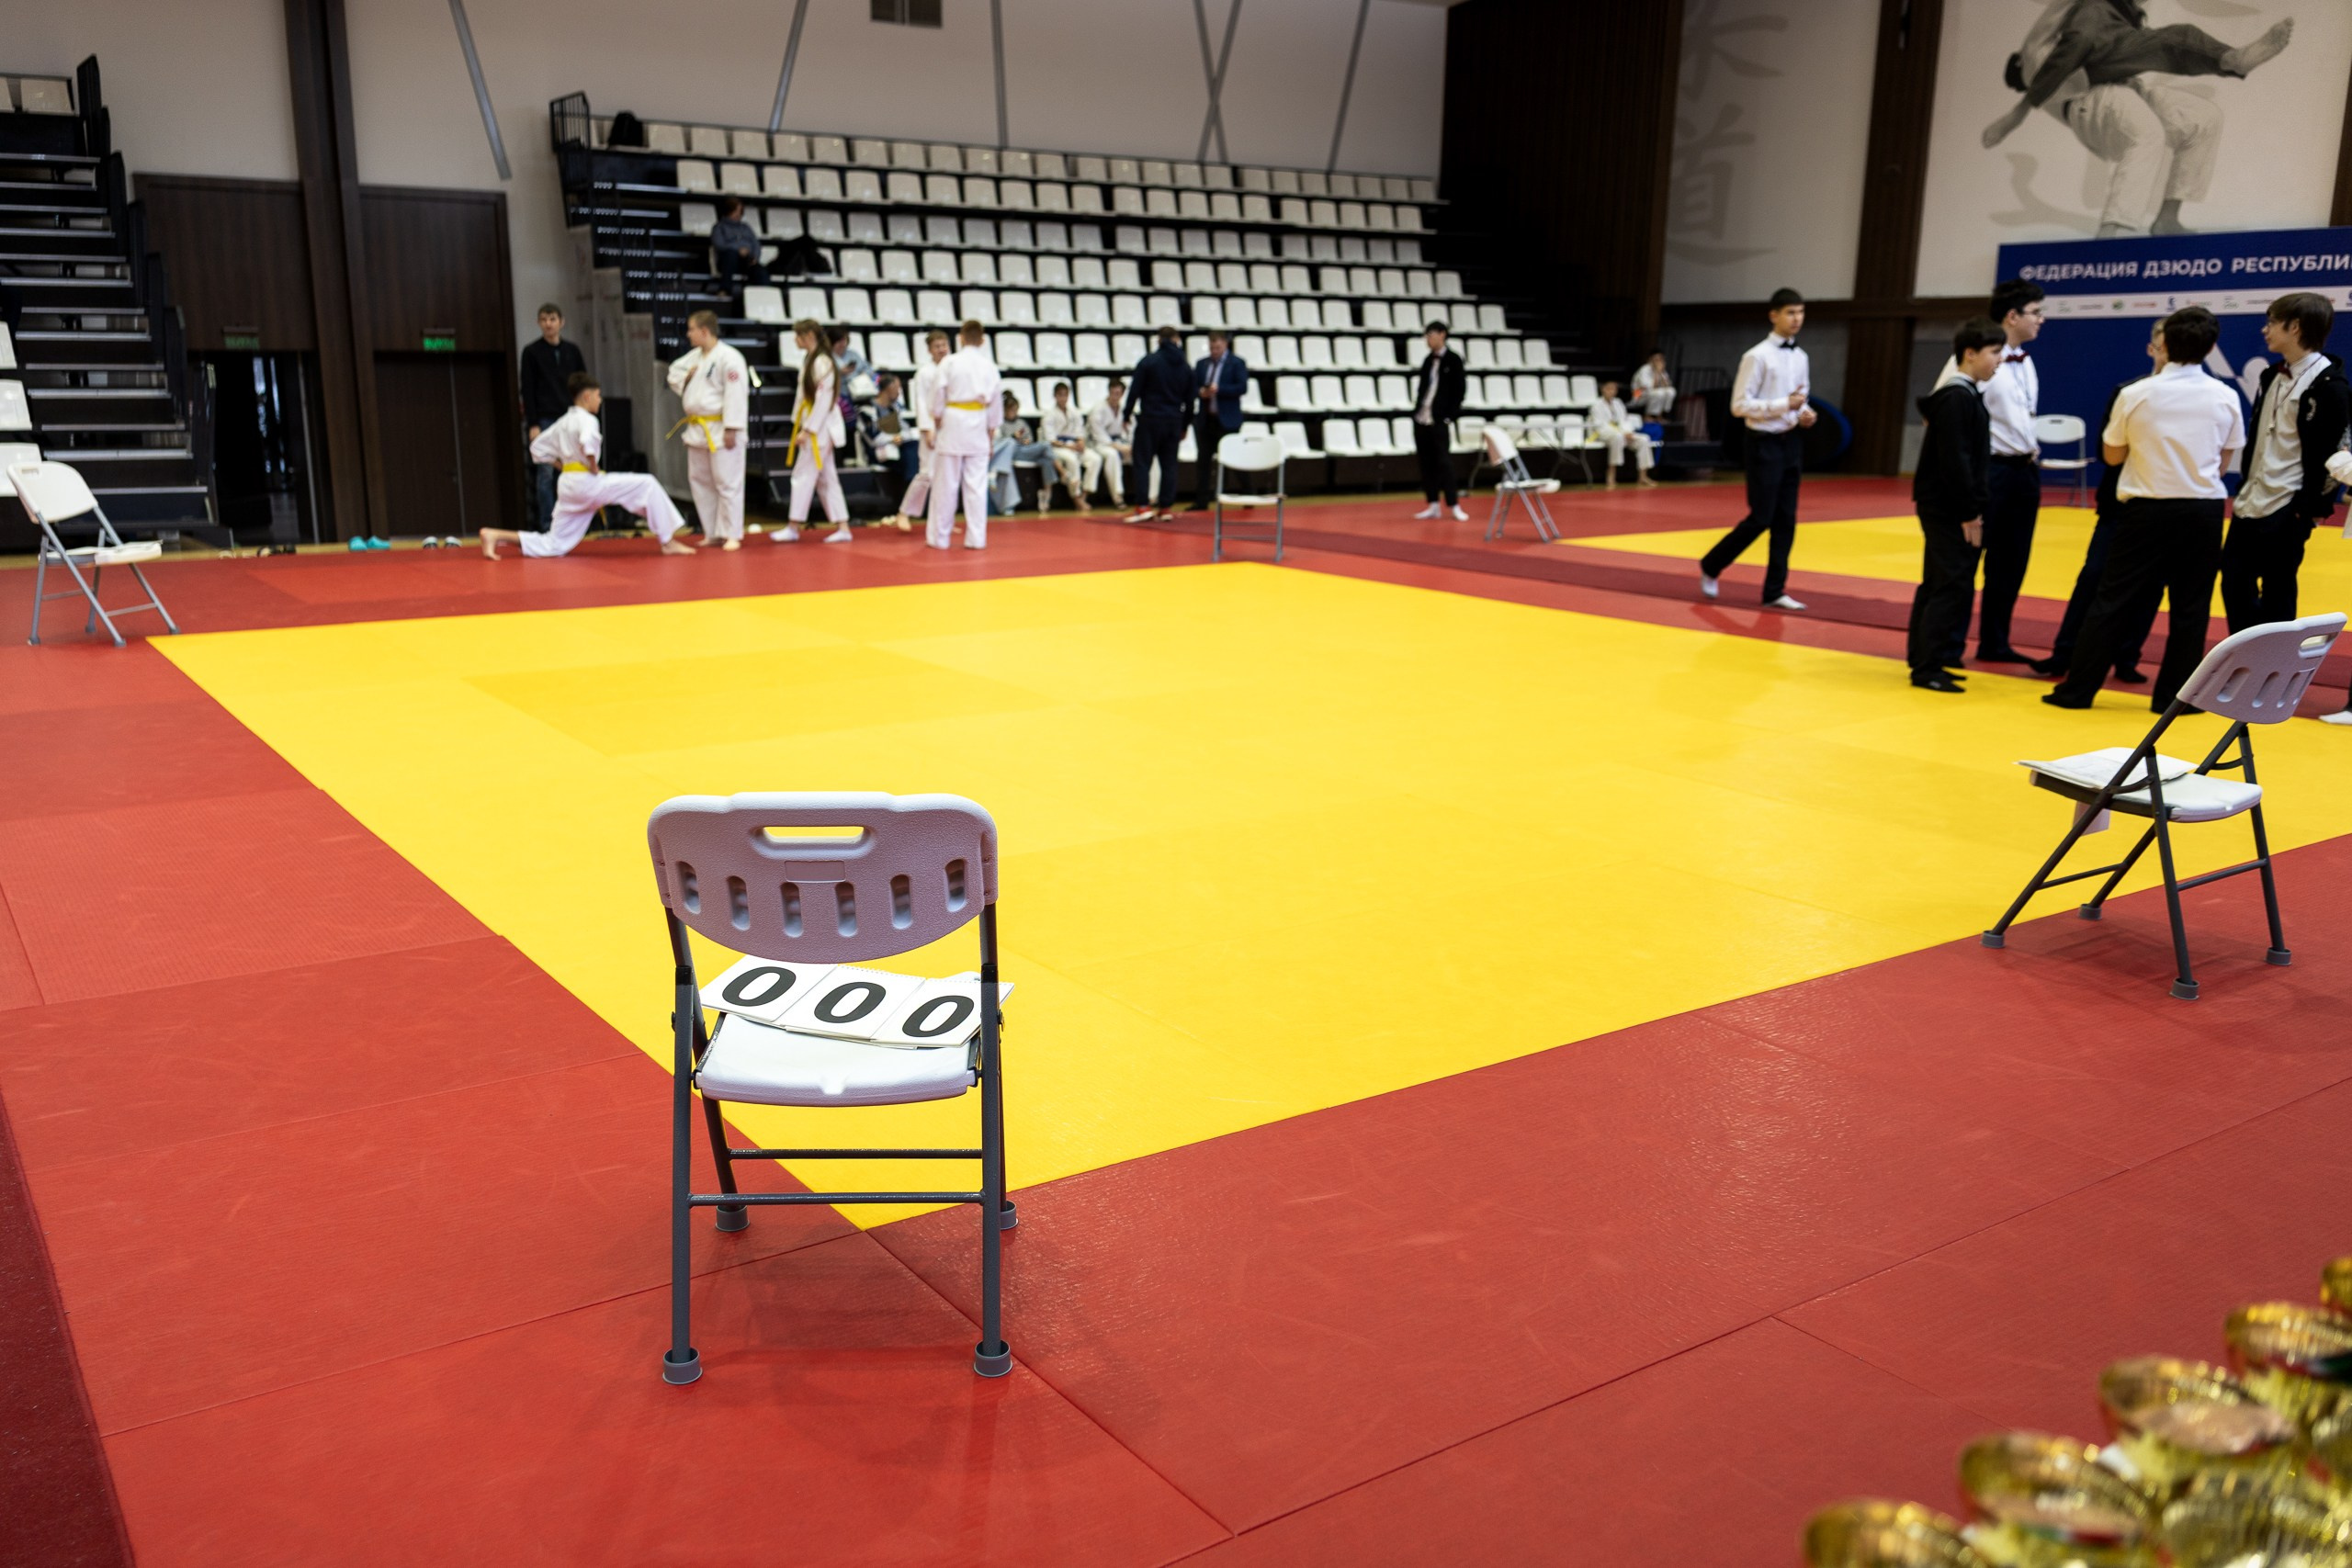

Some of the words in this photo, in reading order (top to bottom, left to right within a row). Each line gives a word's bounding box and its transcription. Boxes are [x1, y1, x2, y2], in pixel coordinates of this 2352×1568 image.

[2019, 261, 2139, 281] ФЕДЕРАЦИЯ
[2143, 258, 2222, 277] ДЗЮДО
[2231, 254, 2352, 273] РЕСПУБЛИ
